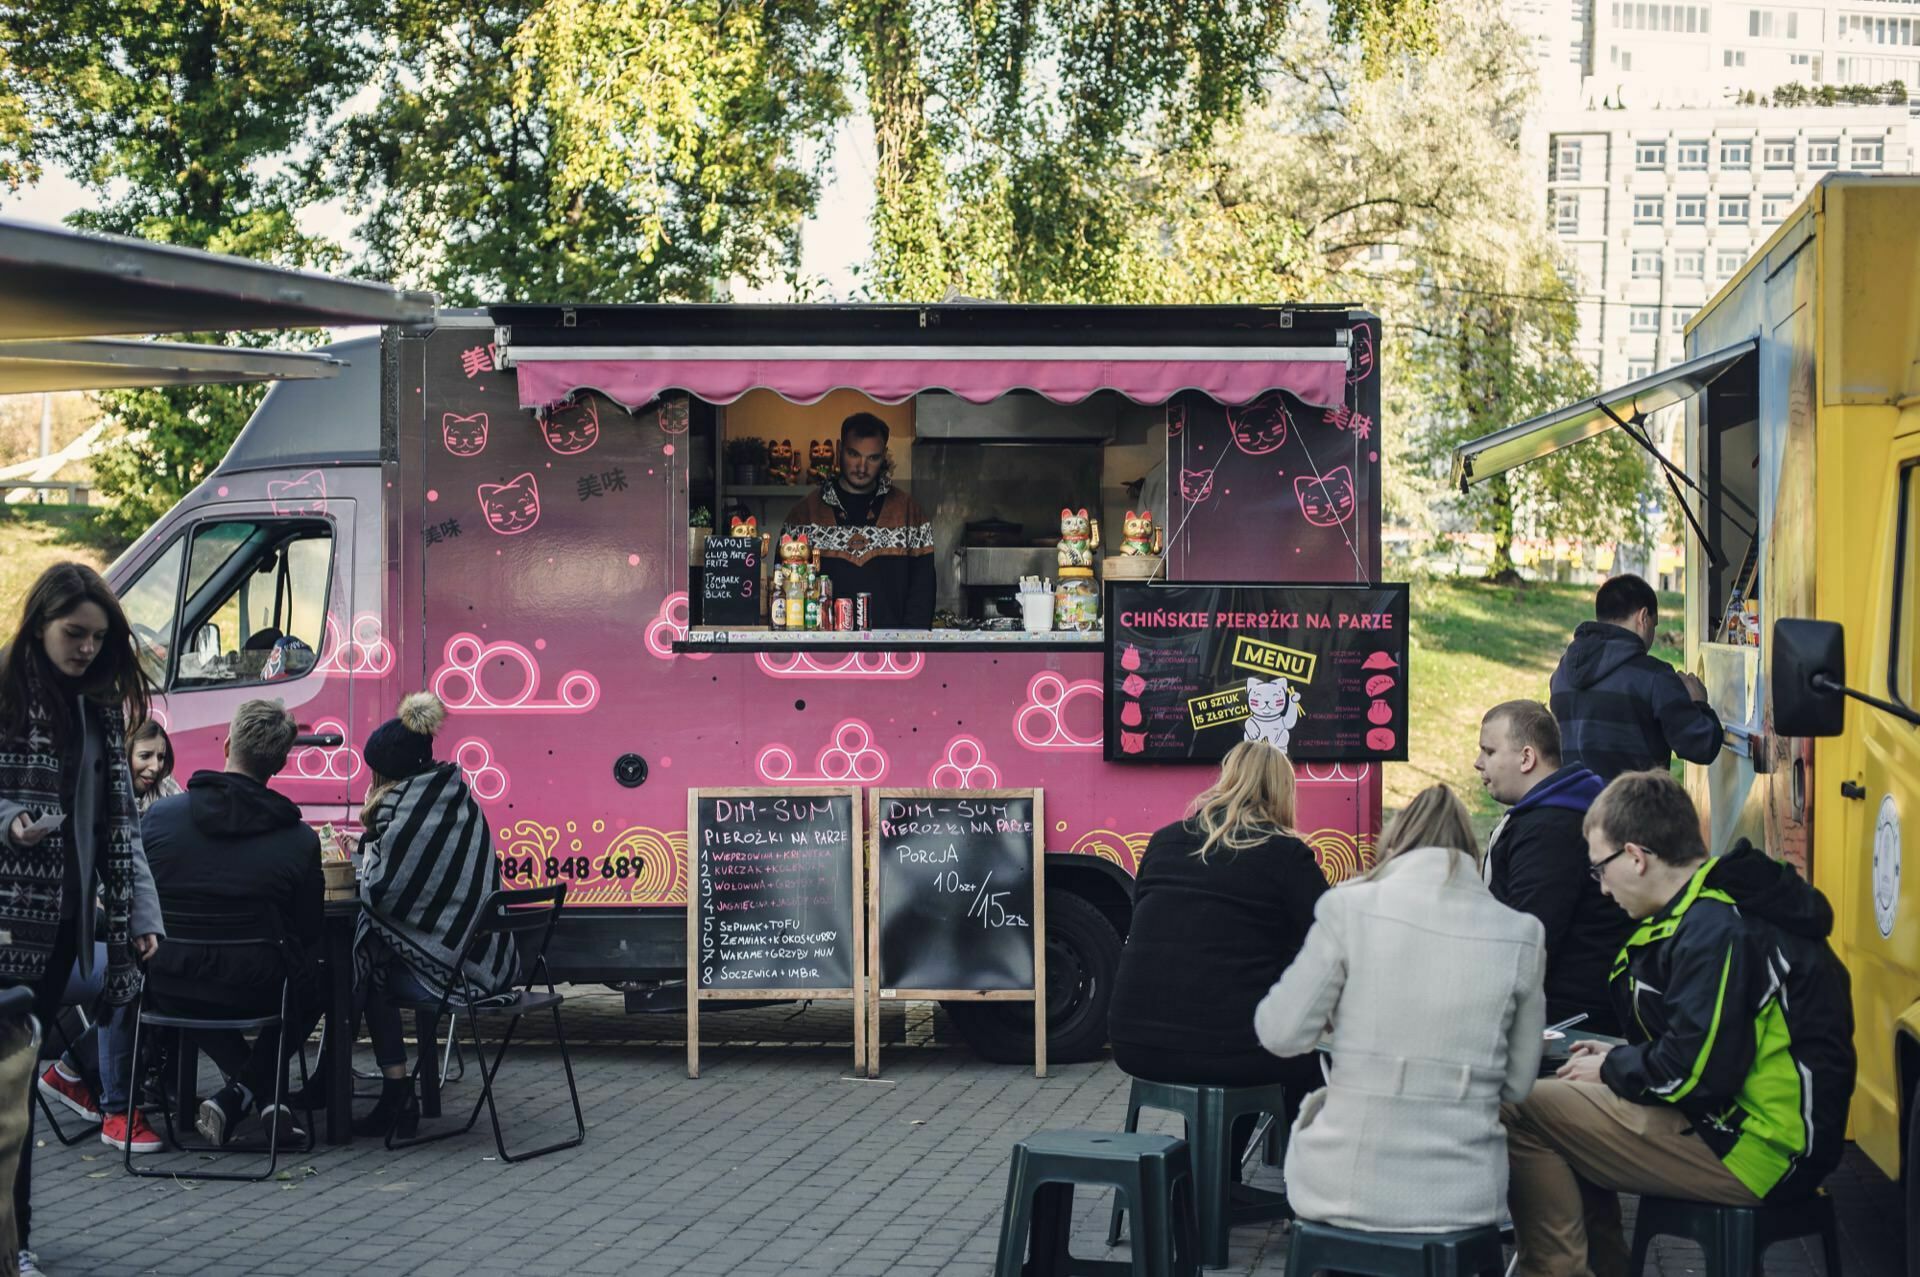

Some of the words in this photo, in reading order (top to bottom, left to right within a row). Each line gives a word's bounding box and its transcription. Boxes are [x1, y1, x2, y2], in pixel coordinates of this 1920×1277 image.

[577, 466, 629, 501] 美味
[421, 517, 462, 548] 美味
[707, 536, 752, 549] NAPOJE
[705, 551, 728, 560] CLUB
[745, 553, 755, 567] 6
[706, 559, 729, 568] FRITZ
[705, 573, 740, 584] TYMBARK
[706, 590, 732, 599] BLACK
[740, 580, 753, 598] 3
[1120, 608, 1209, 628] CHIŃSKIE
[1306, 613, 1331, 629] NA
[1338, 613, 1393, 629] PARZE
[1244, 645, 1306, 674] MENU
[1196, 700, 1208, 711] 10
[1210, 693, 1240, 708] SZTUK
[1194, 714, 1205, 724] 15
[1206, 704, 1249, 722] ZŁOTYCH
[970, 821, 994, 836] NA
[995, 819, 1033, 835] PARZE
[791, 832, 808, 846] NA
[815, 829, 848, 846] PARZE
[701, 849, 708, 862] 1
[896, 844, 959, 865] PORCJA
[499, 856, 533, 880] 84
[545, 856, 590, 880] 848
[601, 856, 645, 880] 689
[701, 863, 711, 877] 2
[702, 878, 712, 897] 3
[703, 898, 714, 915] 4
[704, 917, 716, 932] 5
[703, 932, 714, 948] 6
[702, 949, 715, 964] 7
[813, 947, 835, 959] MUN
[702, 966, 714, 985] 8
